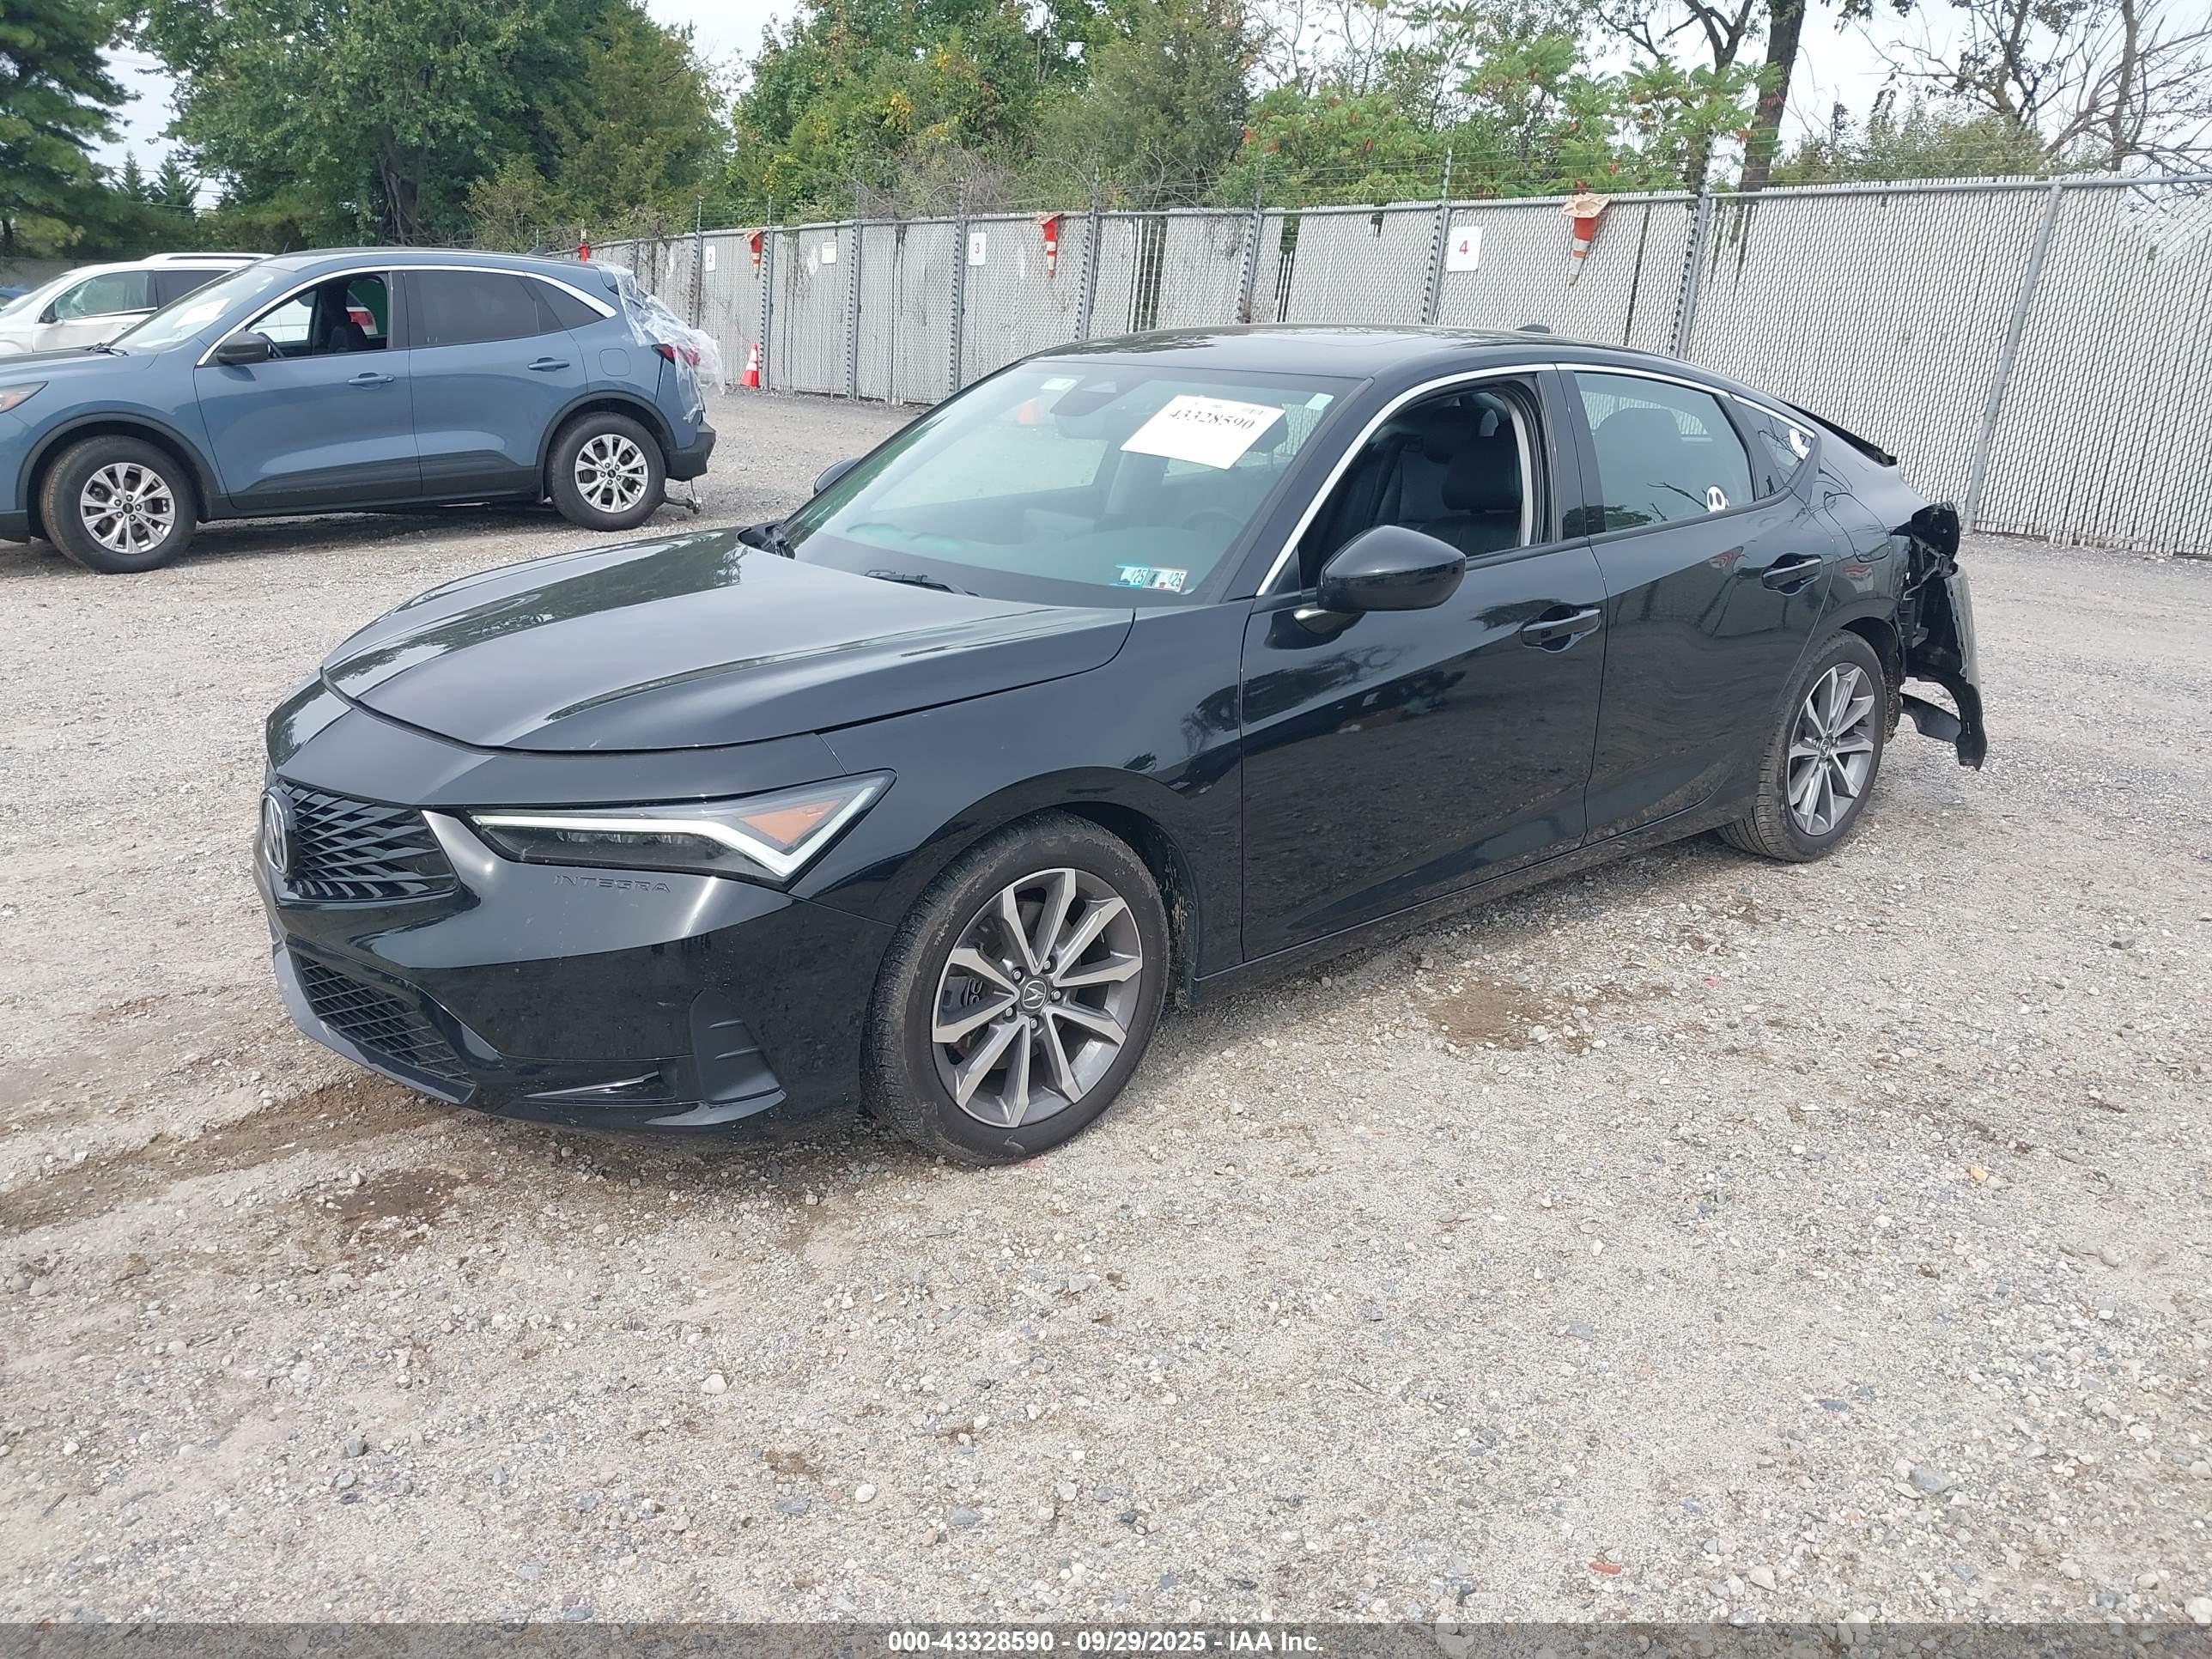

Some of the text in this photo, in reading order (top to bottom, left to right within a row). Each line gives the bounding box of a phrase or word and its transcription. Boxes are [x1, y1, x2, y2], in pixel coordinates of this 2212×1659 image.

[975, 242, 981, 254] 3
[1459, 240, 1469, 255] 4
[1169, 410, 1255, 429] 43328590
[554, 875, 672, 894] INTEGRA
